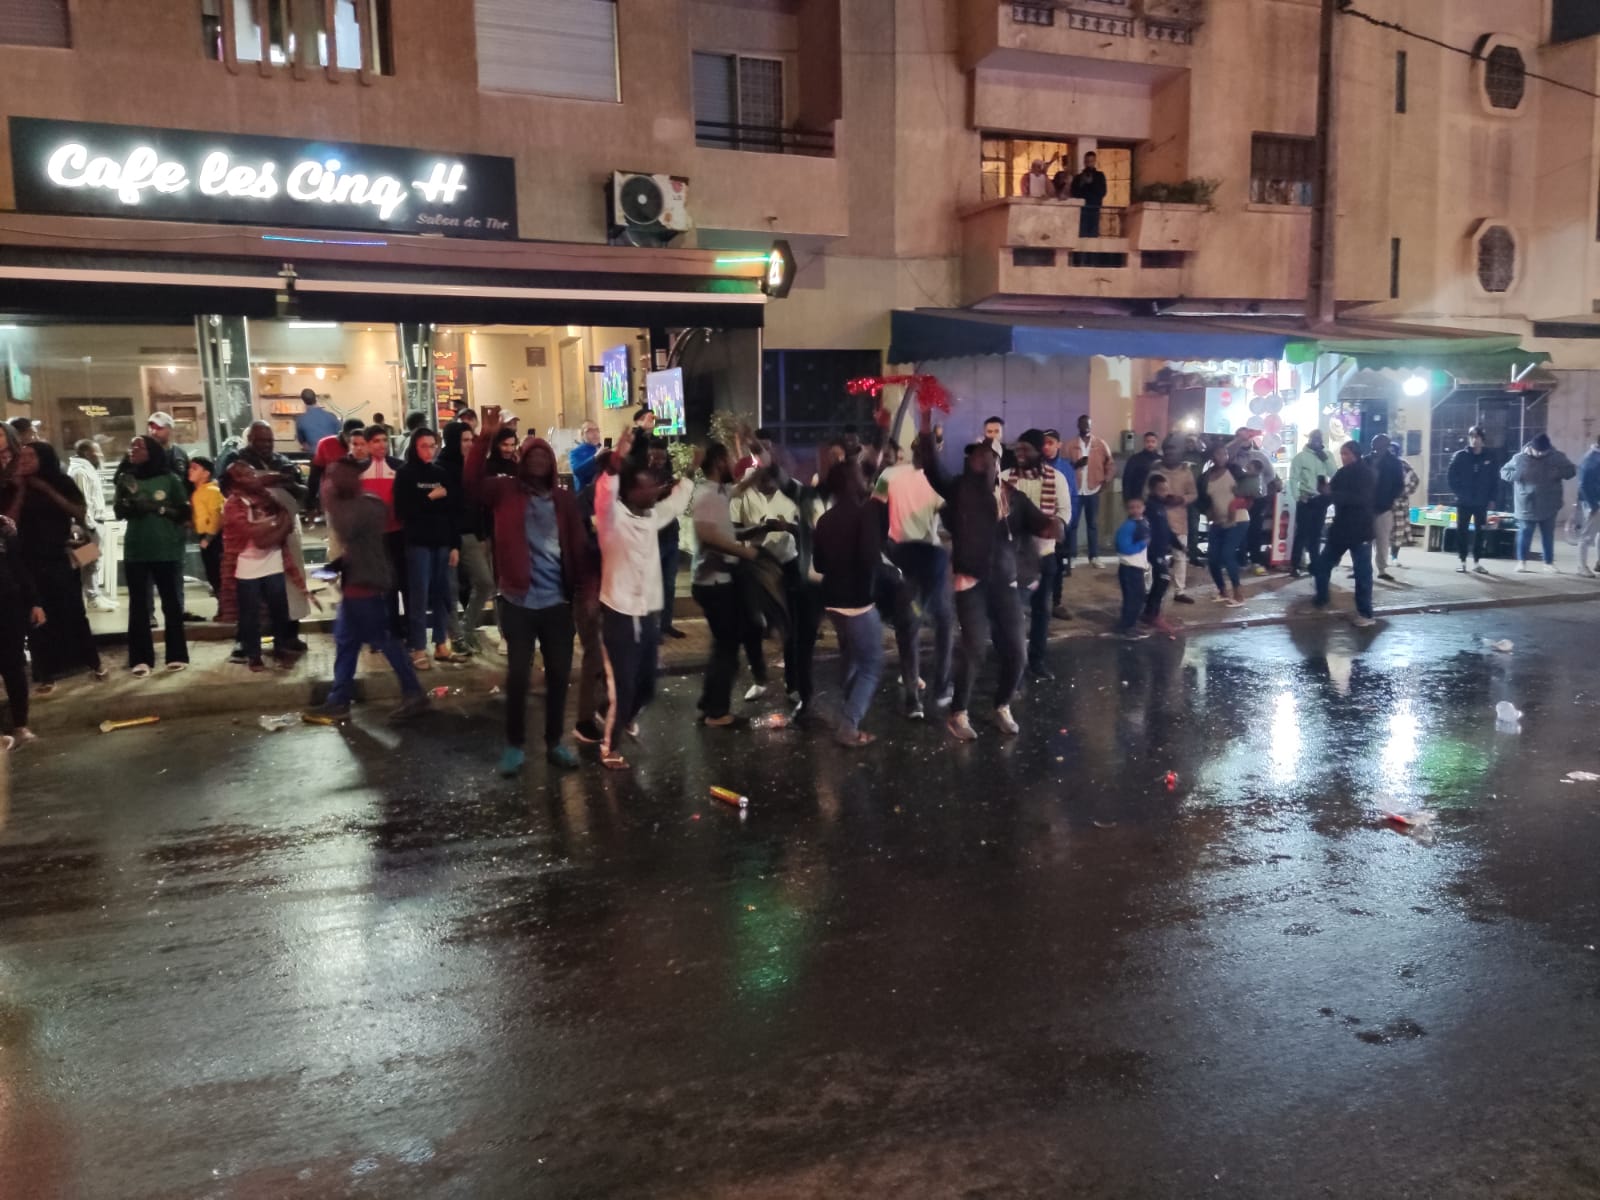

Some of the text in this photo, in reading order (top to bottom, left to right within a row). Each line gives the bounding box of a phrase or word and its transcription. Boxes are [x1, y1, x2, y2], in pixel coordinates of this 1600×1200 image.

[48, 143, 467, 221] Cafe les Cinq H
[416, 212, 460, 227] Salon
[463, 216, 481, 228] de
